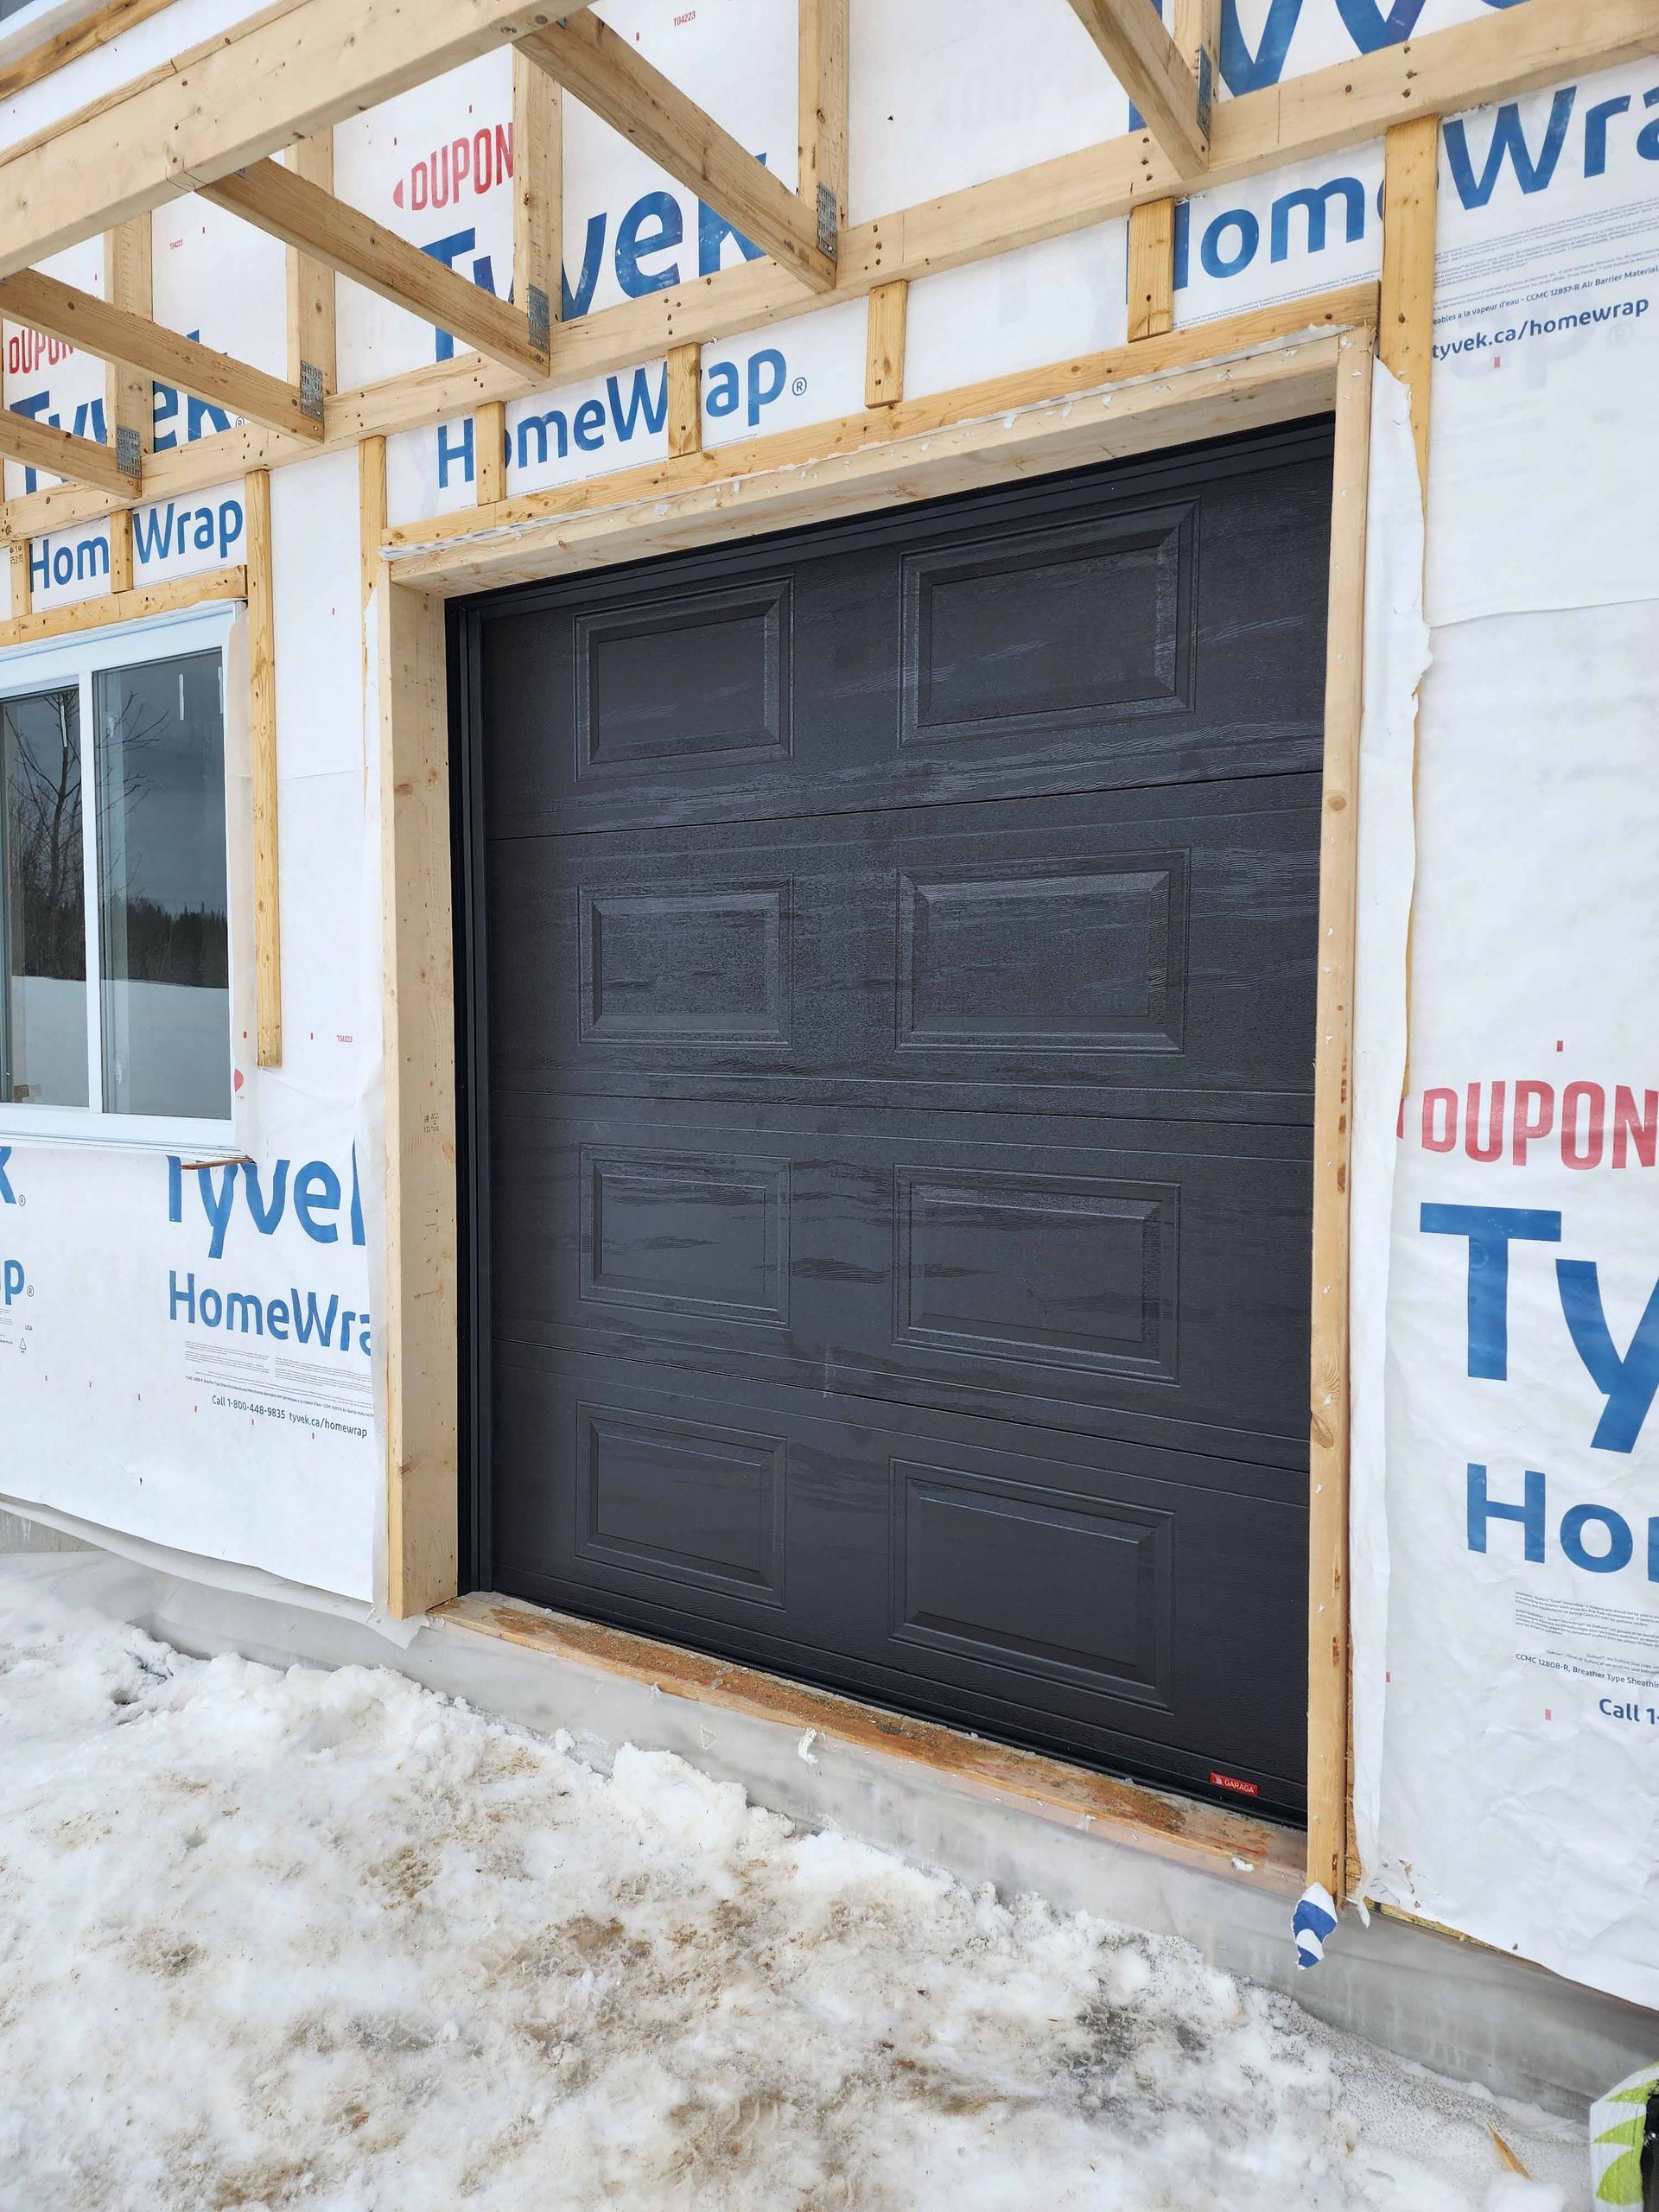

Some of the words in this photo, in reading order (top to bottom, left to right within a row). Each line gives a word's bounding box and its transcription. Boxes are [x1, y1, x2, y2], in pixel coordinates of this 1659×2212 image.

[673, 10, 696, 27] T04223
[411, 123, 513, 211] DUPON
[1471, 303, 1498, 316] vapeur
[1526, 291, 1548, 302] CCMC
[1581, 280, 1593, 290] Air
[1595, 274, 1623, 286] Barrier
[1432, 298, 1649, 361] tyvek.ca/homewrap
[30, 499, 244, 594] HomWrap
[337, 1034, 353, 1043] T04223
[212, 1395, 226, 1407] Call
[227, 1398, 286, 1420] 1-800-448-9835
[289, 1412, 368, 1439] tyvek.ca/homewrap
[1516, 1653, 1536, 1664] CCMC
[1573, 1666, 1605, 1679] Breather
[1607, 1674, 1625, 1683] Type
[1599, 1699, 1640, 1722] Call
[1224, 1778, 1255, 1795] GARAGA
